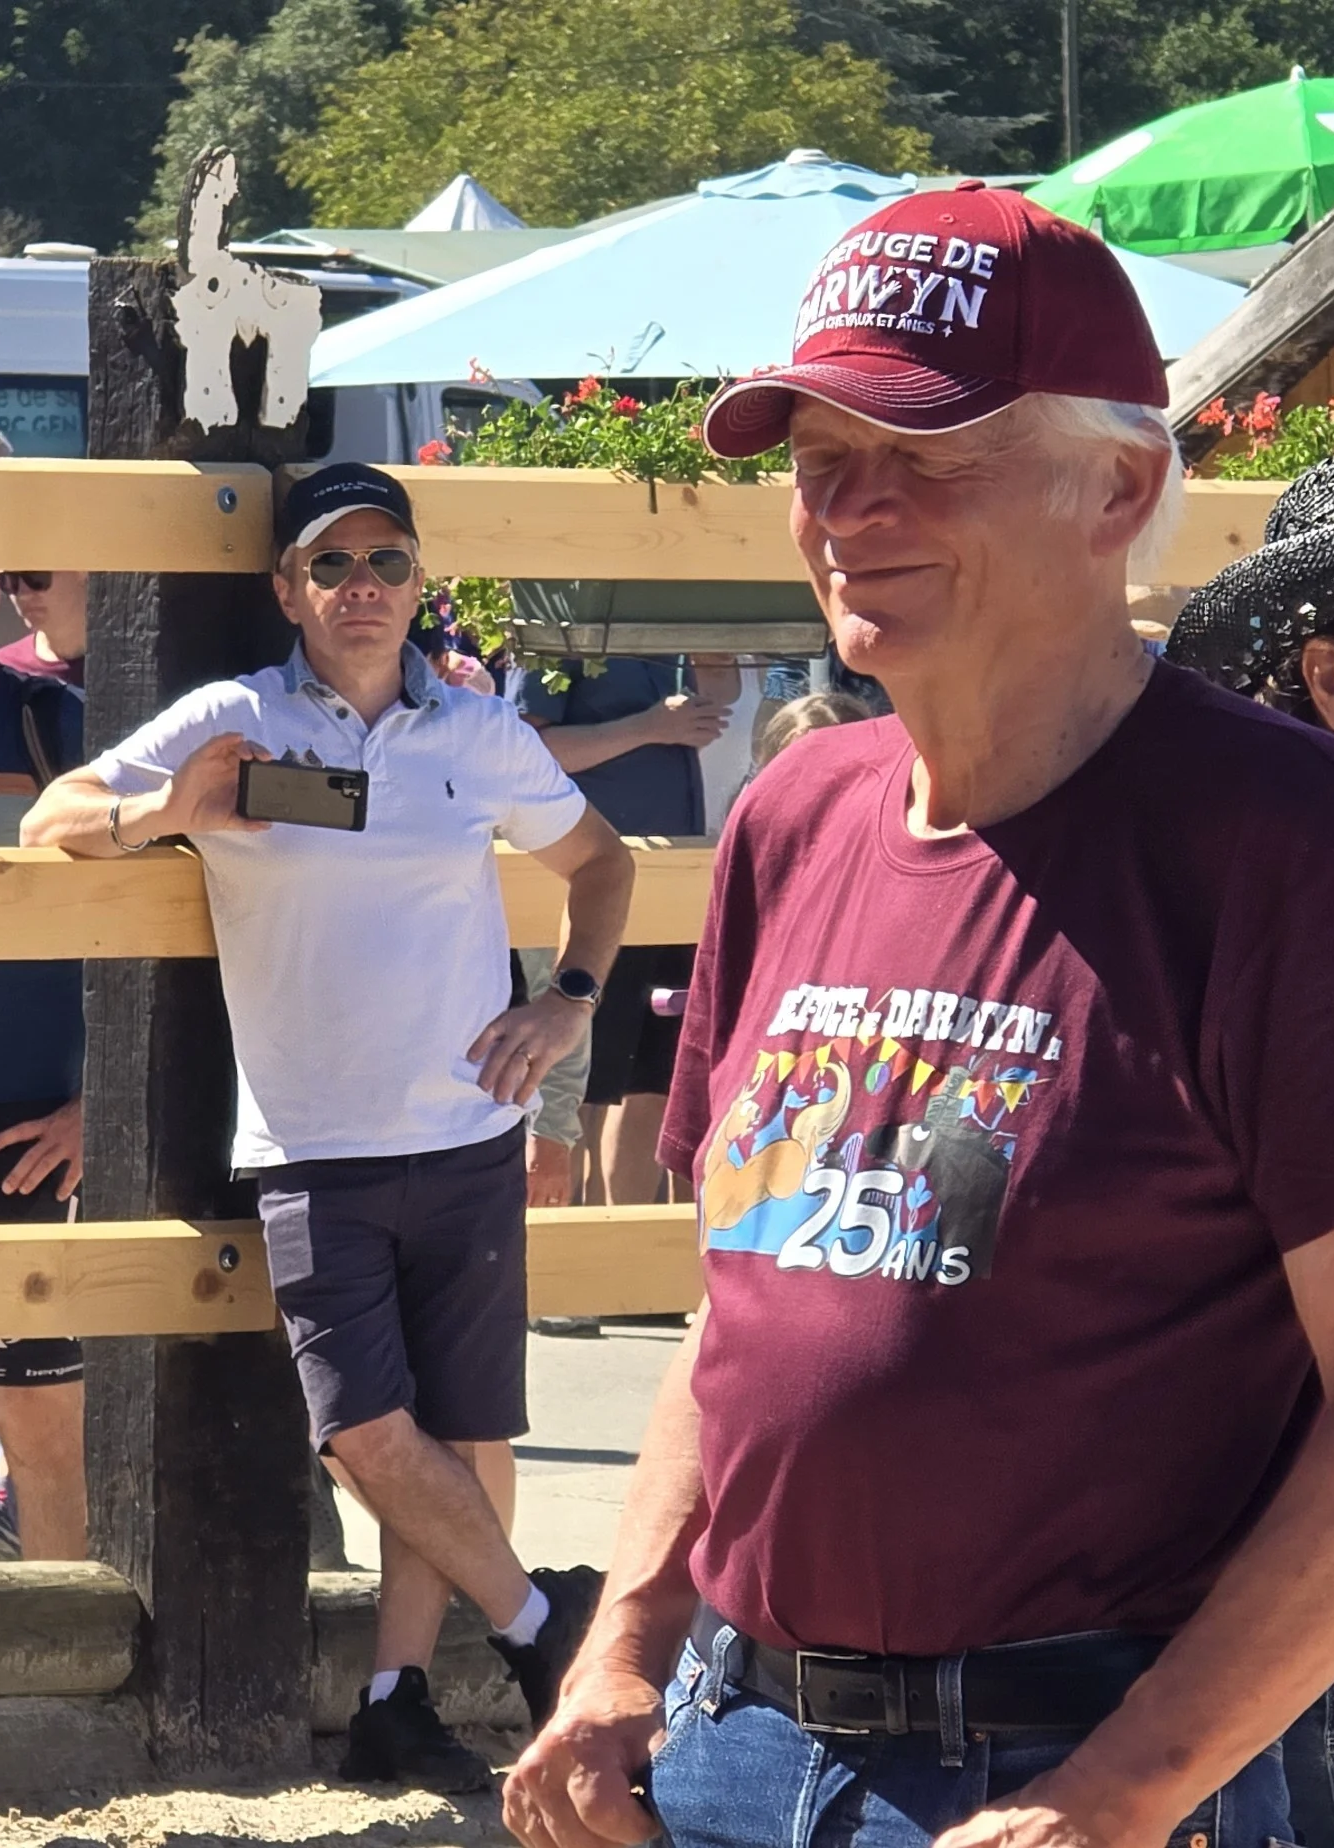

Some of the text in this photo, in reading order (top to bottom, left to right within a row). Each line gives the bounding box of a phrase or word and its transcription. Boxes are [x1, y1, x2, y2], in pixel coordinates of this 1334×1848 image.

[943, 237, 1000, 280] DE
[797, 265, 988, 329] DARWYN
[825, 313, 875, 330] CHEVAUX
[876, 313, 896, 328] ET
[777, 1168, 971, 1285] 25 ANS
